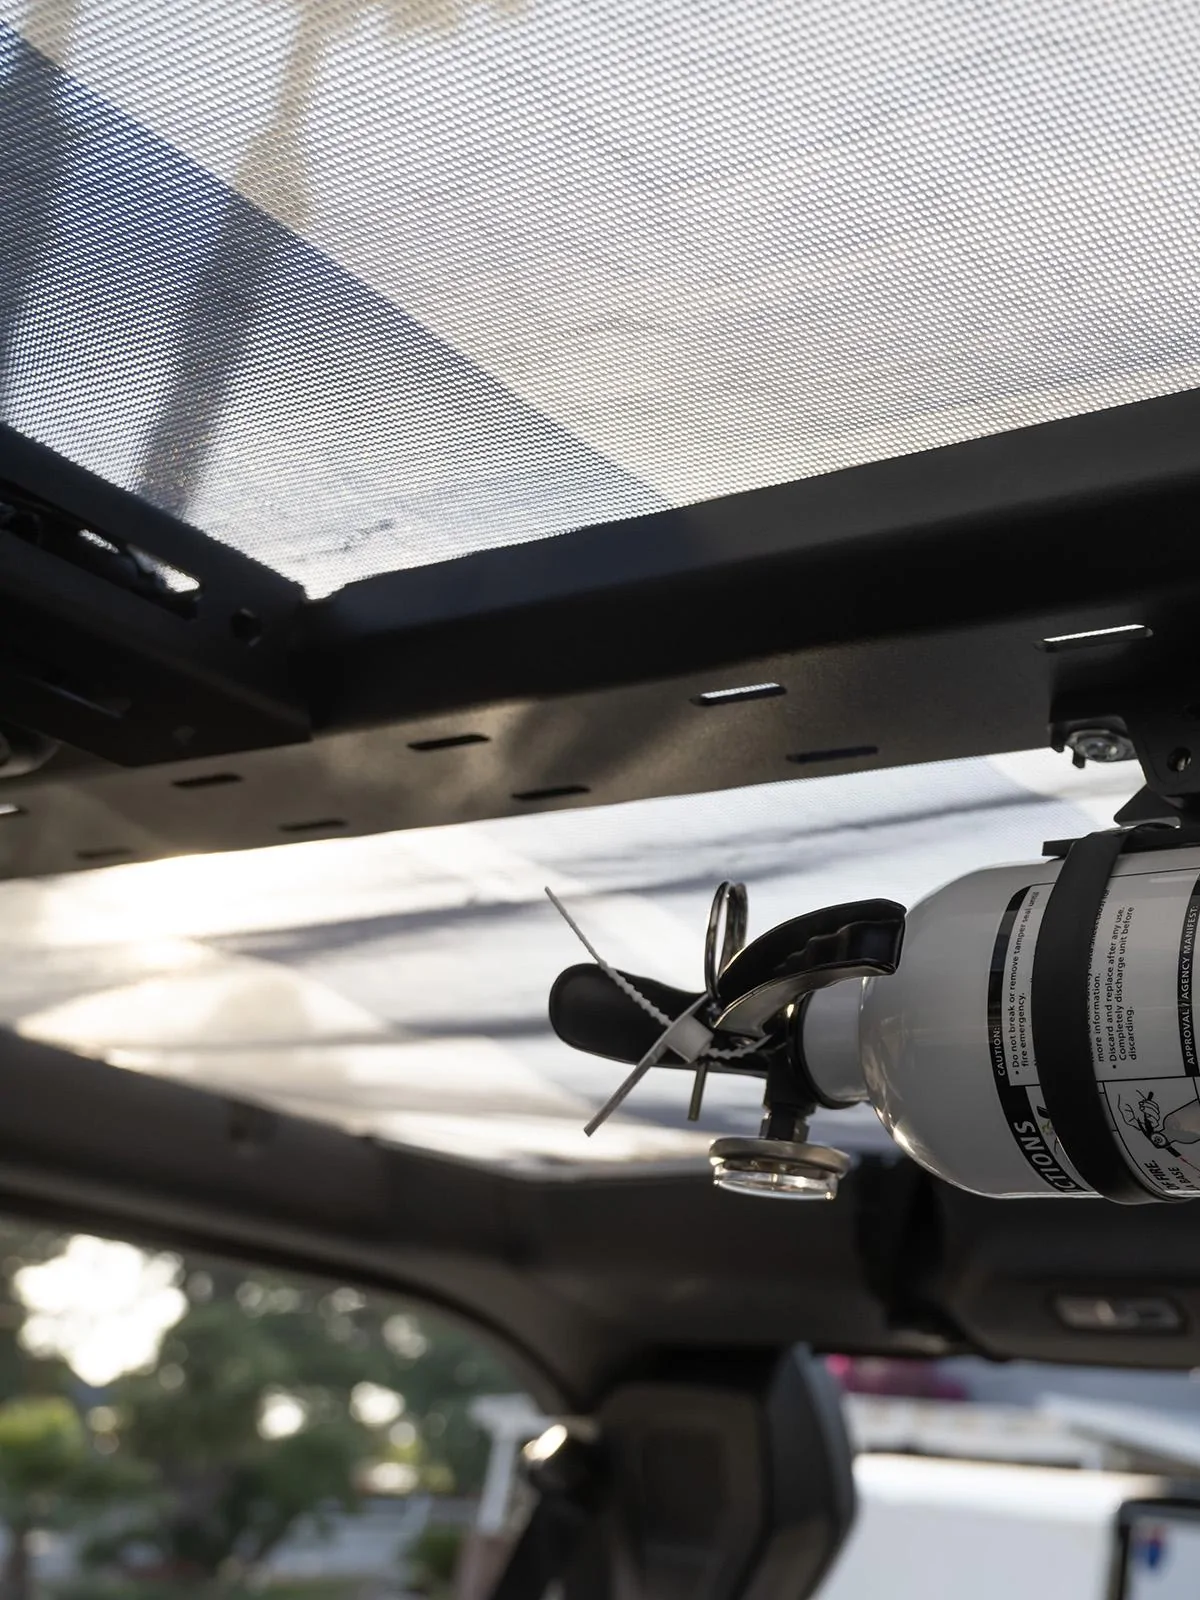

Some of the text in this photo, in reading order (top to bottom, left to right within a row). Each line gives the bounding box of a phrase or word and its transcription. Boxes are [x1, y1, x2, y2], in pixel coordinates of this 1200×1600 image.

[1020, 908, 1032, 922] seal
[1184, 906, 1199, 954] MANIFEST:
[1013, 924, 1027, 954] tamper
[1010, 957, 1019, 990] remove
[1104, 907, 1125, 1061] Discard and replace after any use.
[1114, 907, 1135, 1061] Completely discharge unit before
[1181, 957, 1190, 999] AGENCY
[1009, 992, 1015, 1002] or
[1007, 1006, 1016, 1032] break
[1017, 992, 1029, 1067] fire emergency.
[1092, 973, 1104, 1062] more information.
[1125, 1006, 1137, 1060] discarding.
[993, 1027, 1006, 1076] CAUTION:
[1009, 1035, 1018, 1051] not
[1182, 1009, 1195, 1065] APPROVAL
[1011, 1055, 1020, 1067] Do
[1144, 1160, 1170, 1181] FIRE.
[1167, 1167, 1191, 1183] BASE
